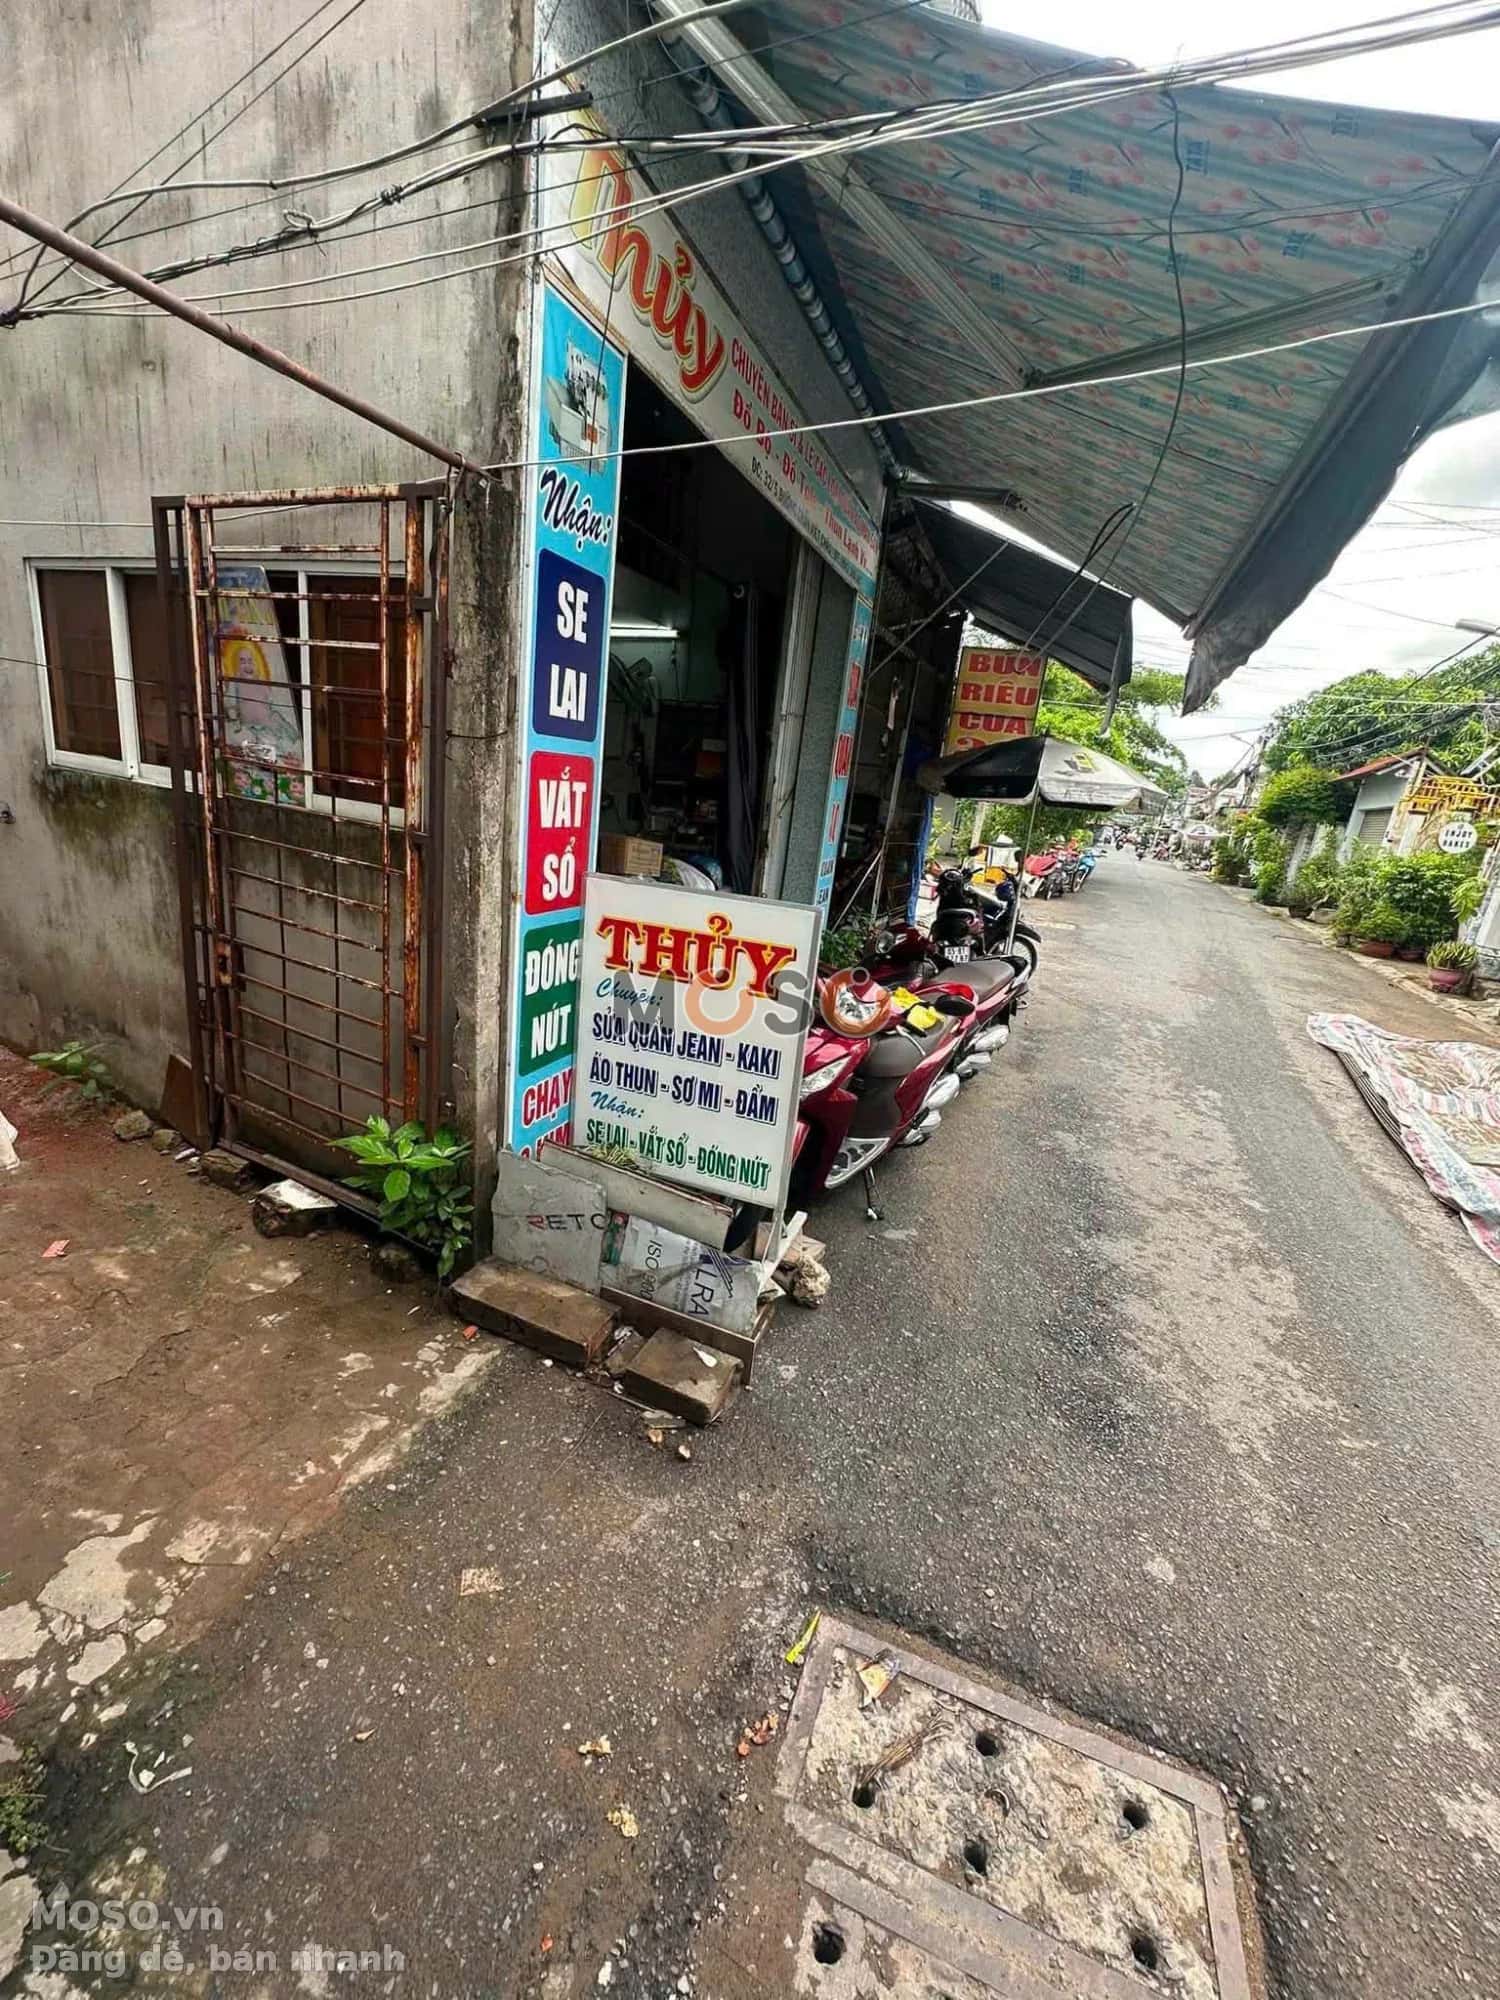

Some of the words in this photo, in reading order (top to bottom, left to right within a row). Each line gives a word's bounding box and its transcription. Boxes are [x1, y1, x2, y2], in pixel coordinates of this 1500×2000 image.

[540, 468, 612, 552] Nhận:
[557, 580, 589, 645] SE
[549, 663, 588, 722] LAI
[961, 681, 1039, 706] RIÊU
[959, 712, 1027, 735] CUA
[538, 765, 587, 829] VẮT
[542, 836, 577, 901] SỔ
[525, 938, 583, 997] ĐÓNG
[597, 913, 797, 1000] THỦY
[596, 977, 664, 1007] Chuyên:
[530, 1002, 572, 1060] NÚT
[592, 1006, 626, 1046] SỬA
[676, 1031, 723, 1067] JEAN
[737, 1042, 782, 1079] KAKI
[522, 1065, 573, 1128] CHẠY
[590, 1090, 646, 1120] Nhận:
[615, 1061, 658, 1098] THUN
[671, 1075, 698, 1105] SƠ
[698, 1080, 723, 1113] MI
[638, 1125, 665, 1163] VẮT
[739, 1155, 772, 1190] NÚT
[644, 1239, 663, 1271] ISO
